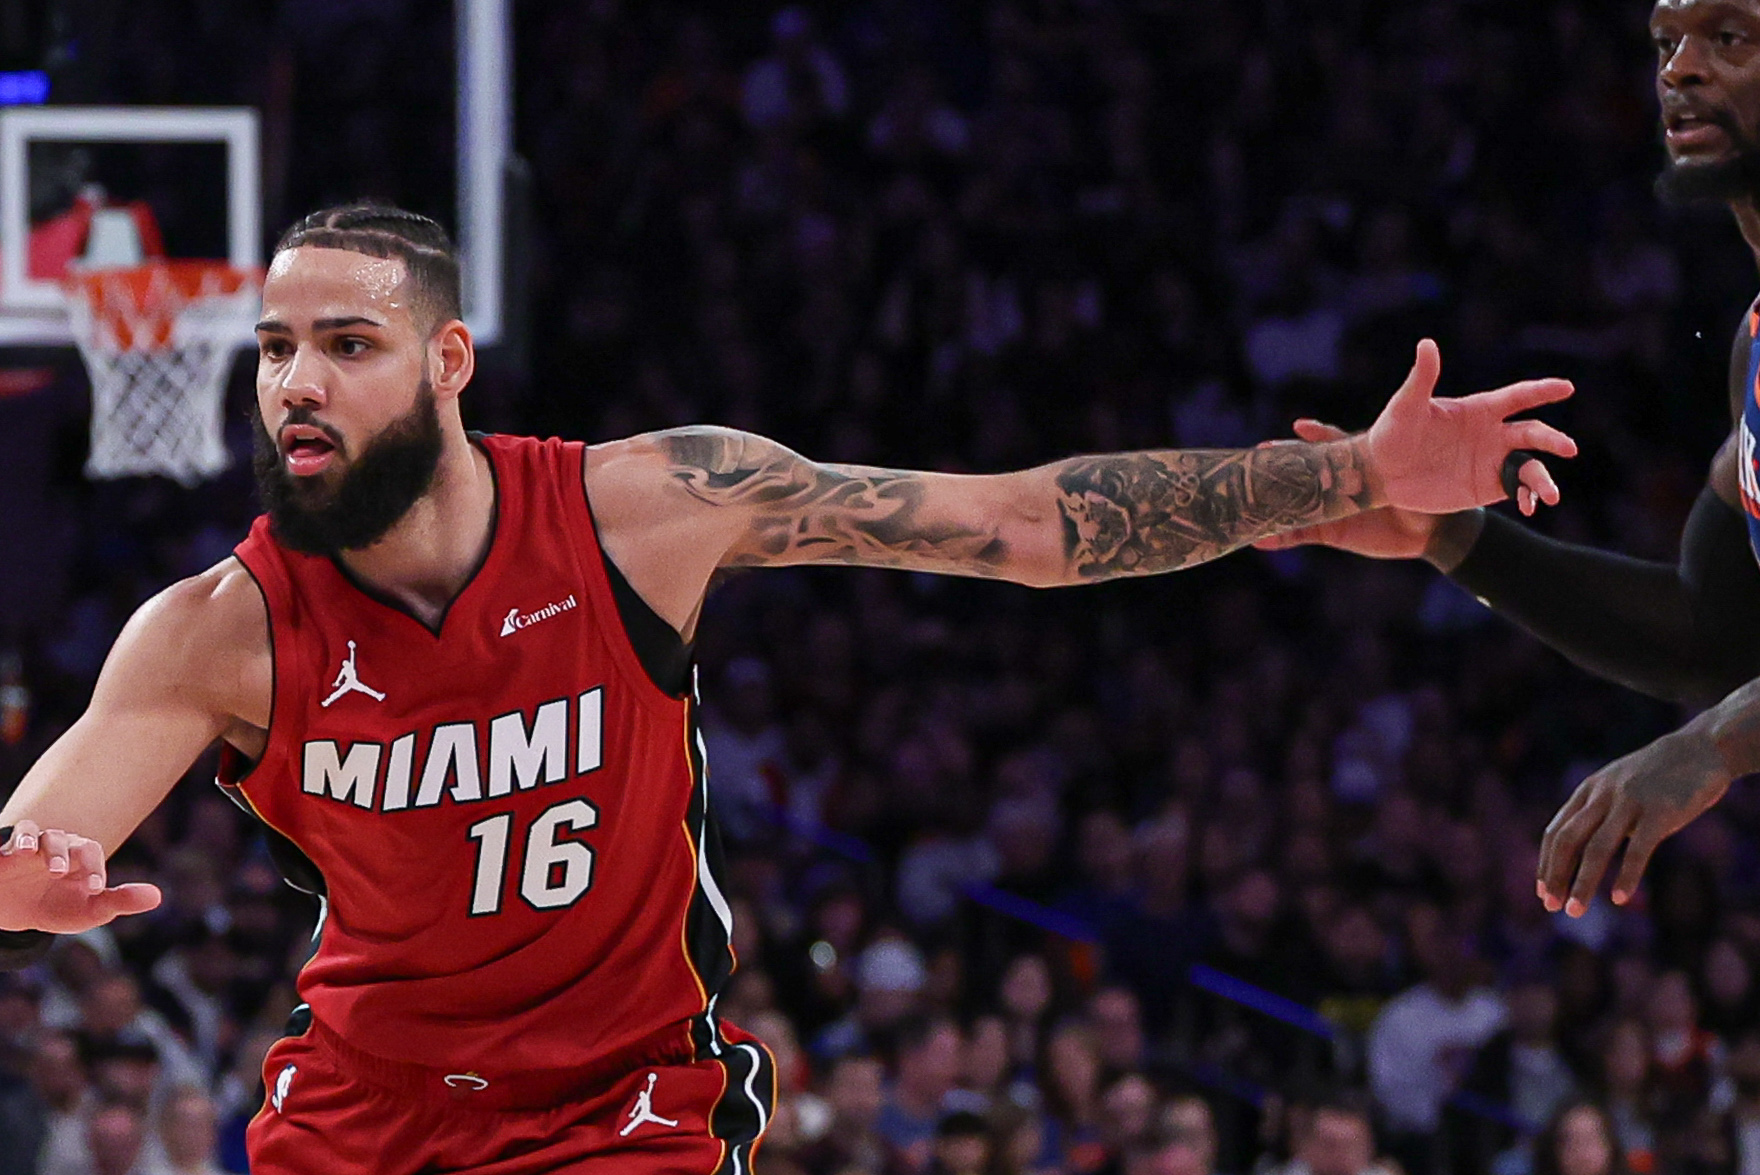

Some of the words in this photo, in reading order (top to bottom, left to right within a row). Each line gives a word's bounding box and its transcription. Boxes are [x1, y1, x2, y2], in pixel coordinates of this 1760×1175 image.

[515, 594, 578, 629] Carnival
[302, 684, 604, 815] MIAMI
[467, 796, 601, 918] 16
